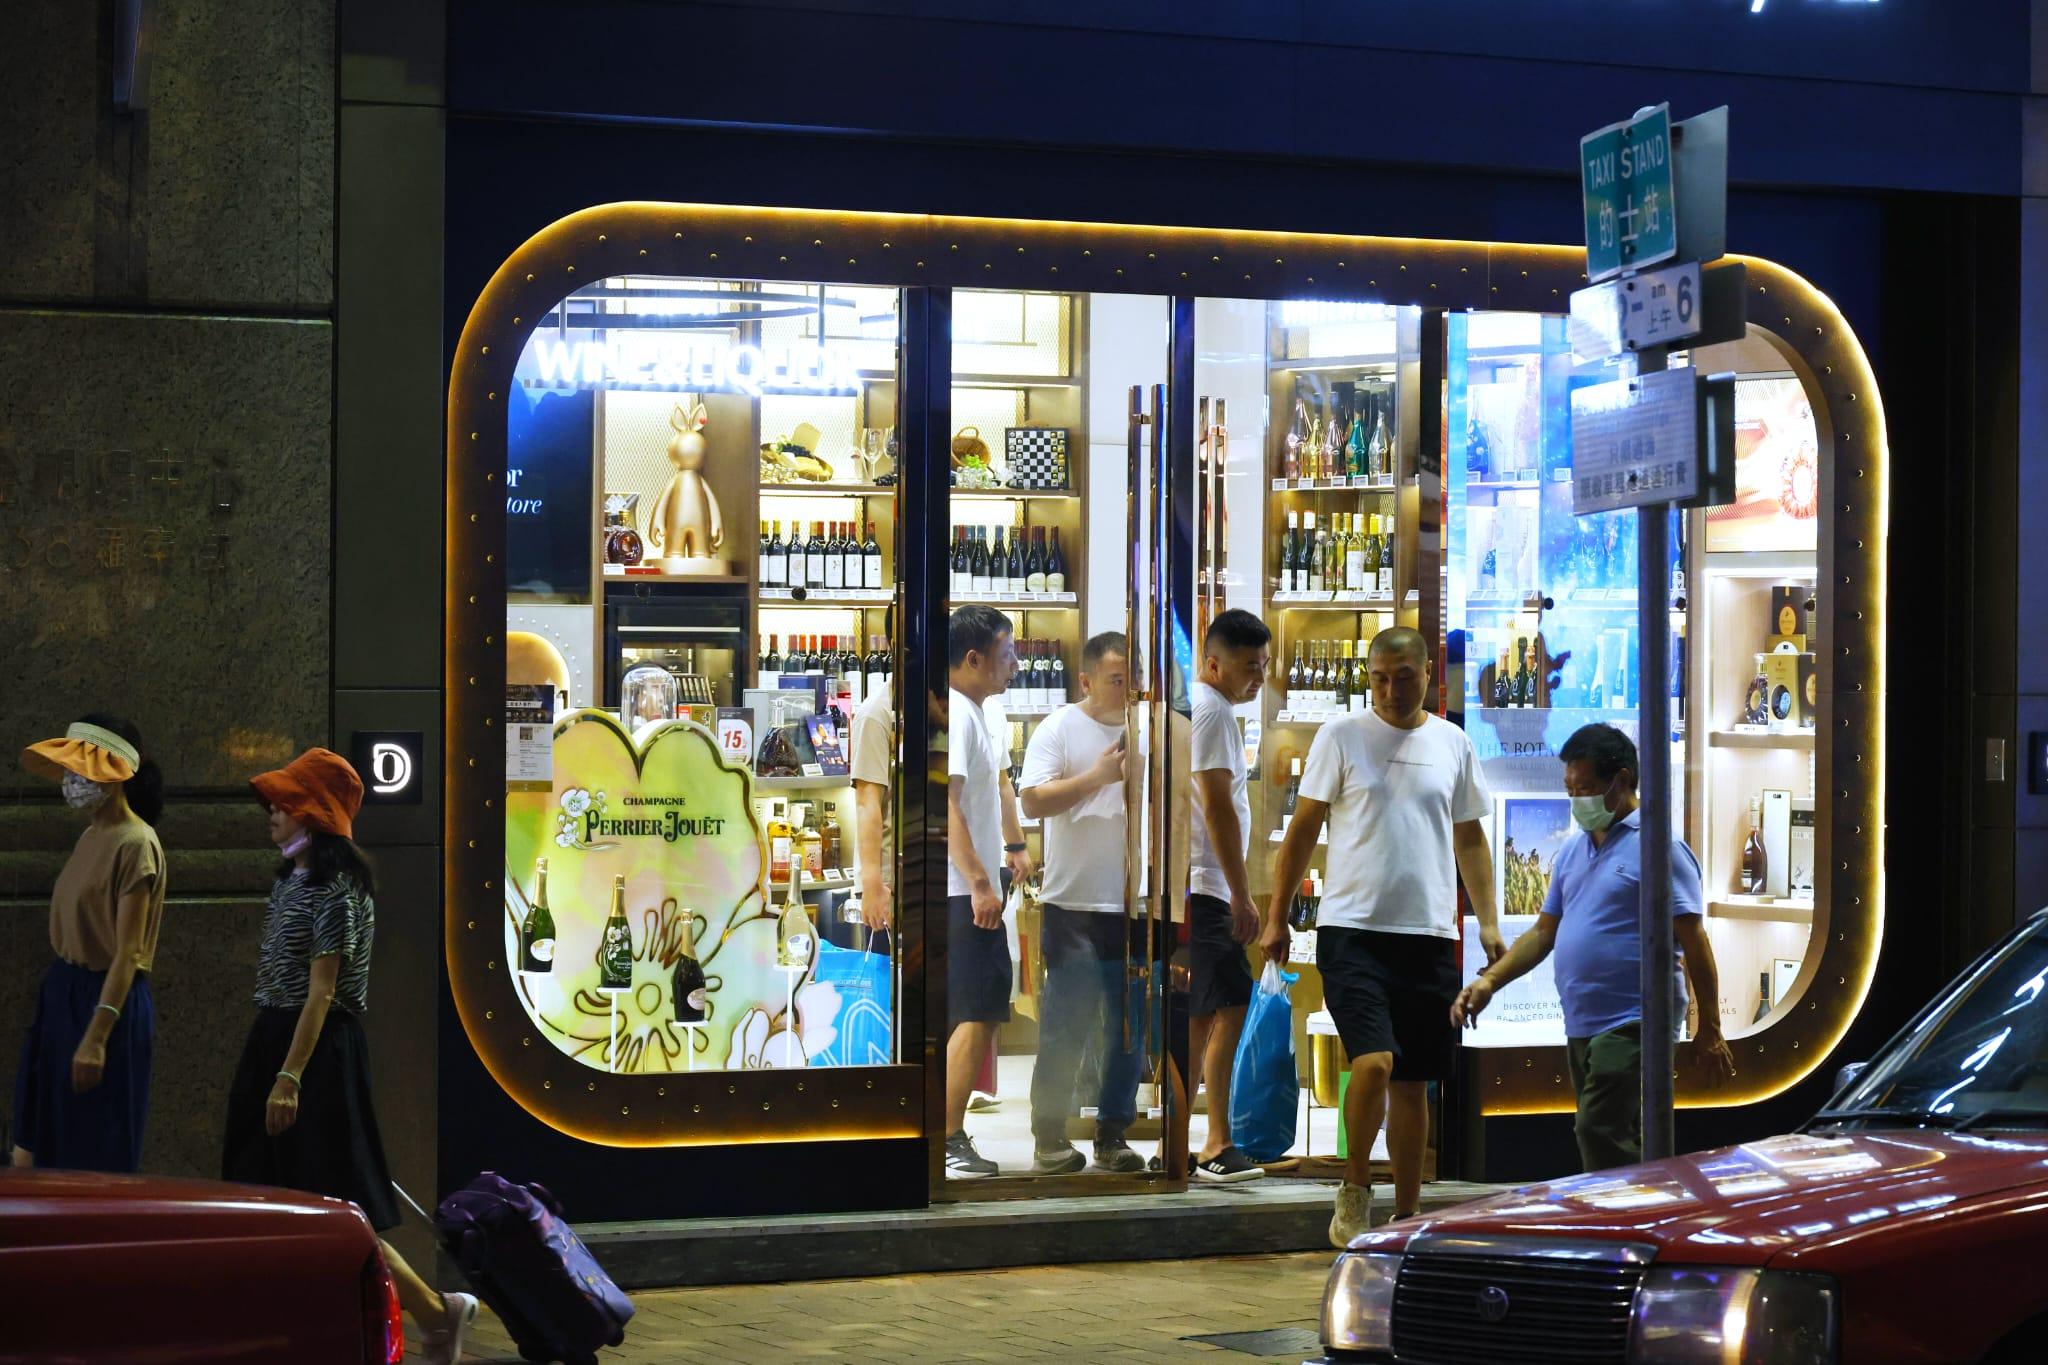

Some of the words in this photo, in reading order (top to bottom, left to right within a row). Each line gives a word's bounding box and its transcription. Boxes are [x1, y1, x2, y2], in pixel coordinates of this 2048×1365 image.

[1588, 151, 1615, 191] TAXI
[1620, 134, 1664, 179] STAND
[1599, 183, 1660, 250] 的士站
[1677, 275, 1693, 323] 6
[724, 730, 742, 749] 15
[623, 797, 686, 806] CHAMPAGNE
[1503, 1002, 1548, 1011] DISCOVER
